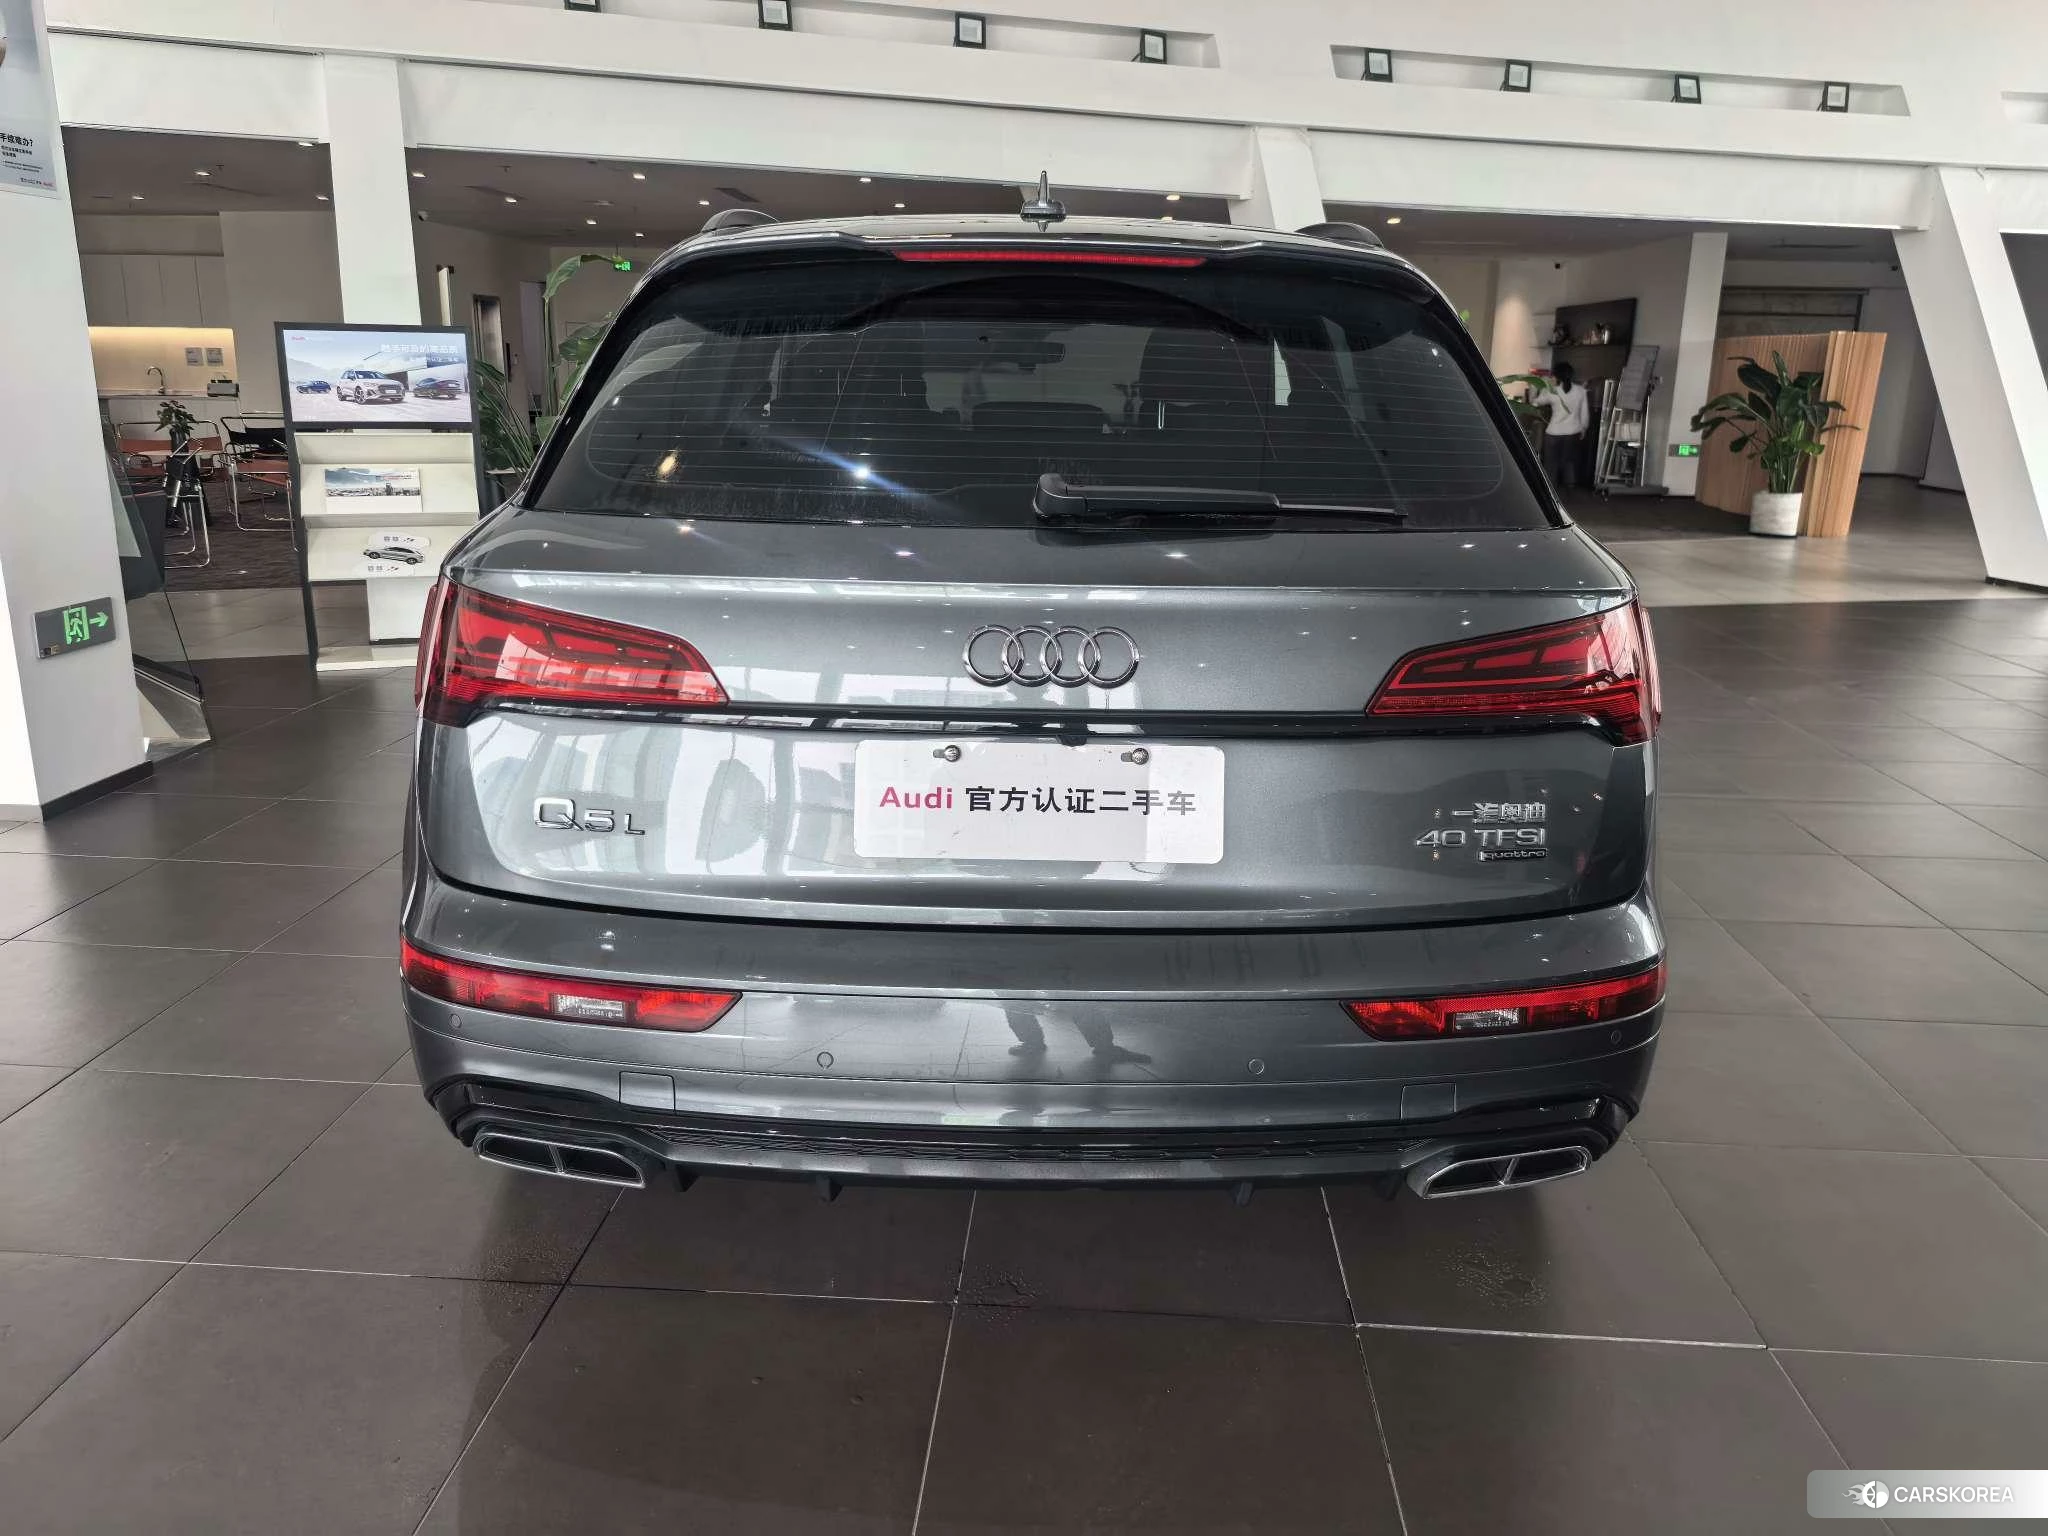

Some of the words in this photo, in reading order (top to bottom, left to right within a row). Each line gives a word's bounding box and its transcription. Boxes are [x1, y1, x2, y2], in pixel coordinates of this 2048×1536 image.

[879, 786, 952, 809] Audi
[965, 786, 1197, 815] 官方认证二手车
[1415, 829, 1467, 847] 40
[1474, 828, 1545, 847] TFSI
[1481, 850, 1546, 861] quattro
